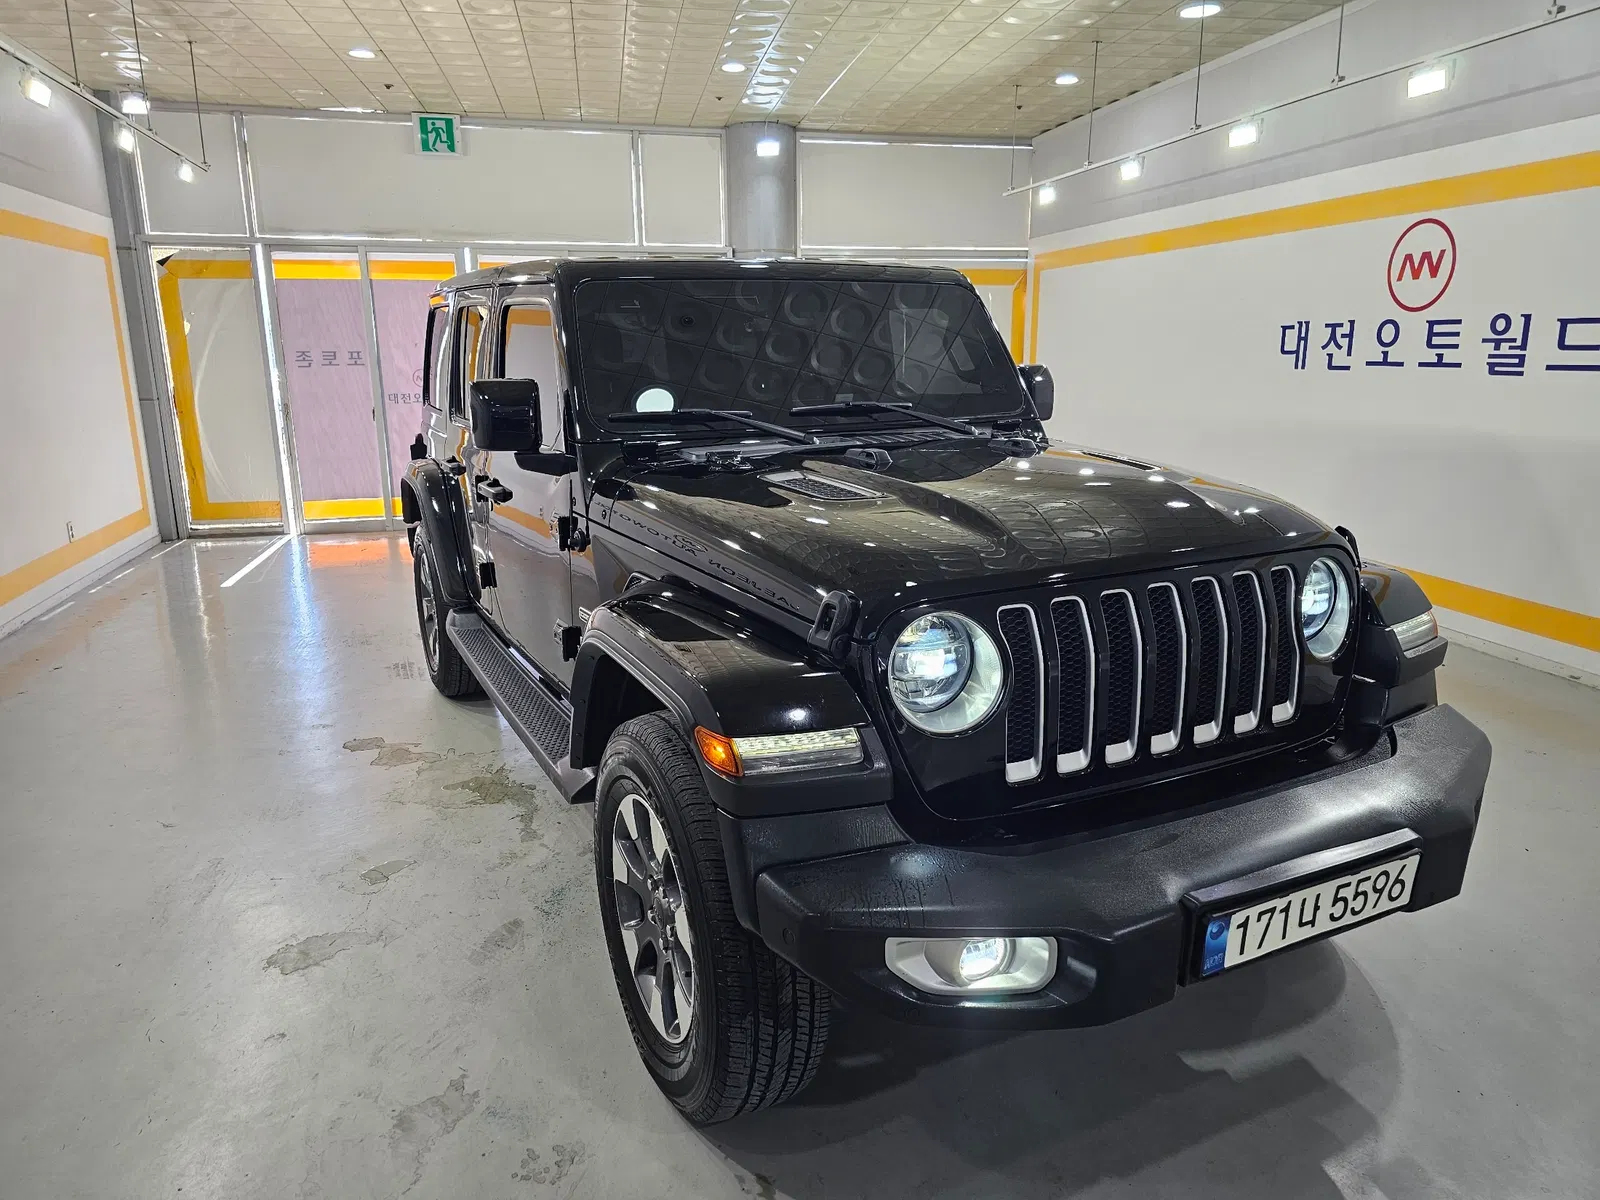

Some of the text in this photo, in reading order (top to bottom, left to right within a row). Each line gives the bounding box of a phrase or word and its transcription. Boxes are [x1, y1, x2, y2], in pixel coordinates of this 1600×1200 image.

[1279, 312, 1600, 377] 대전오토월드
[1235, 863, 1408, 956] 171나 5596
